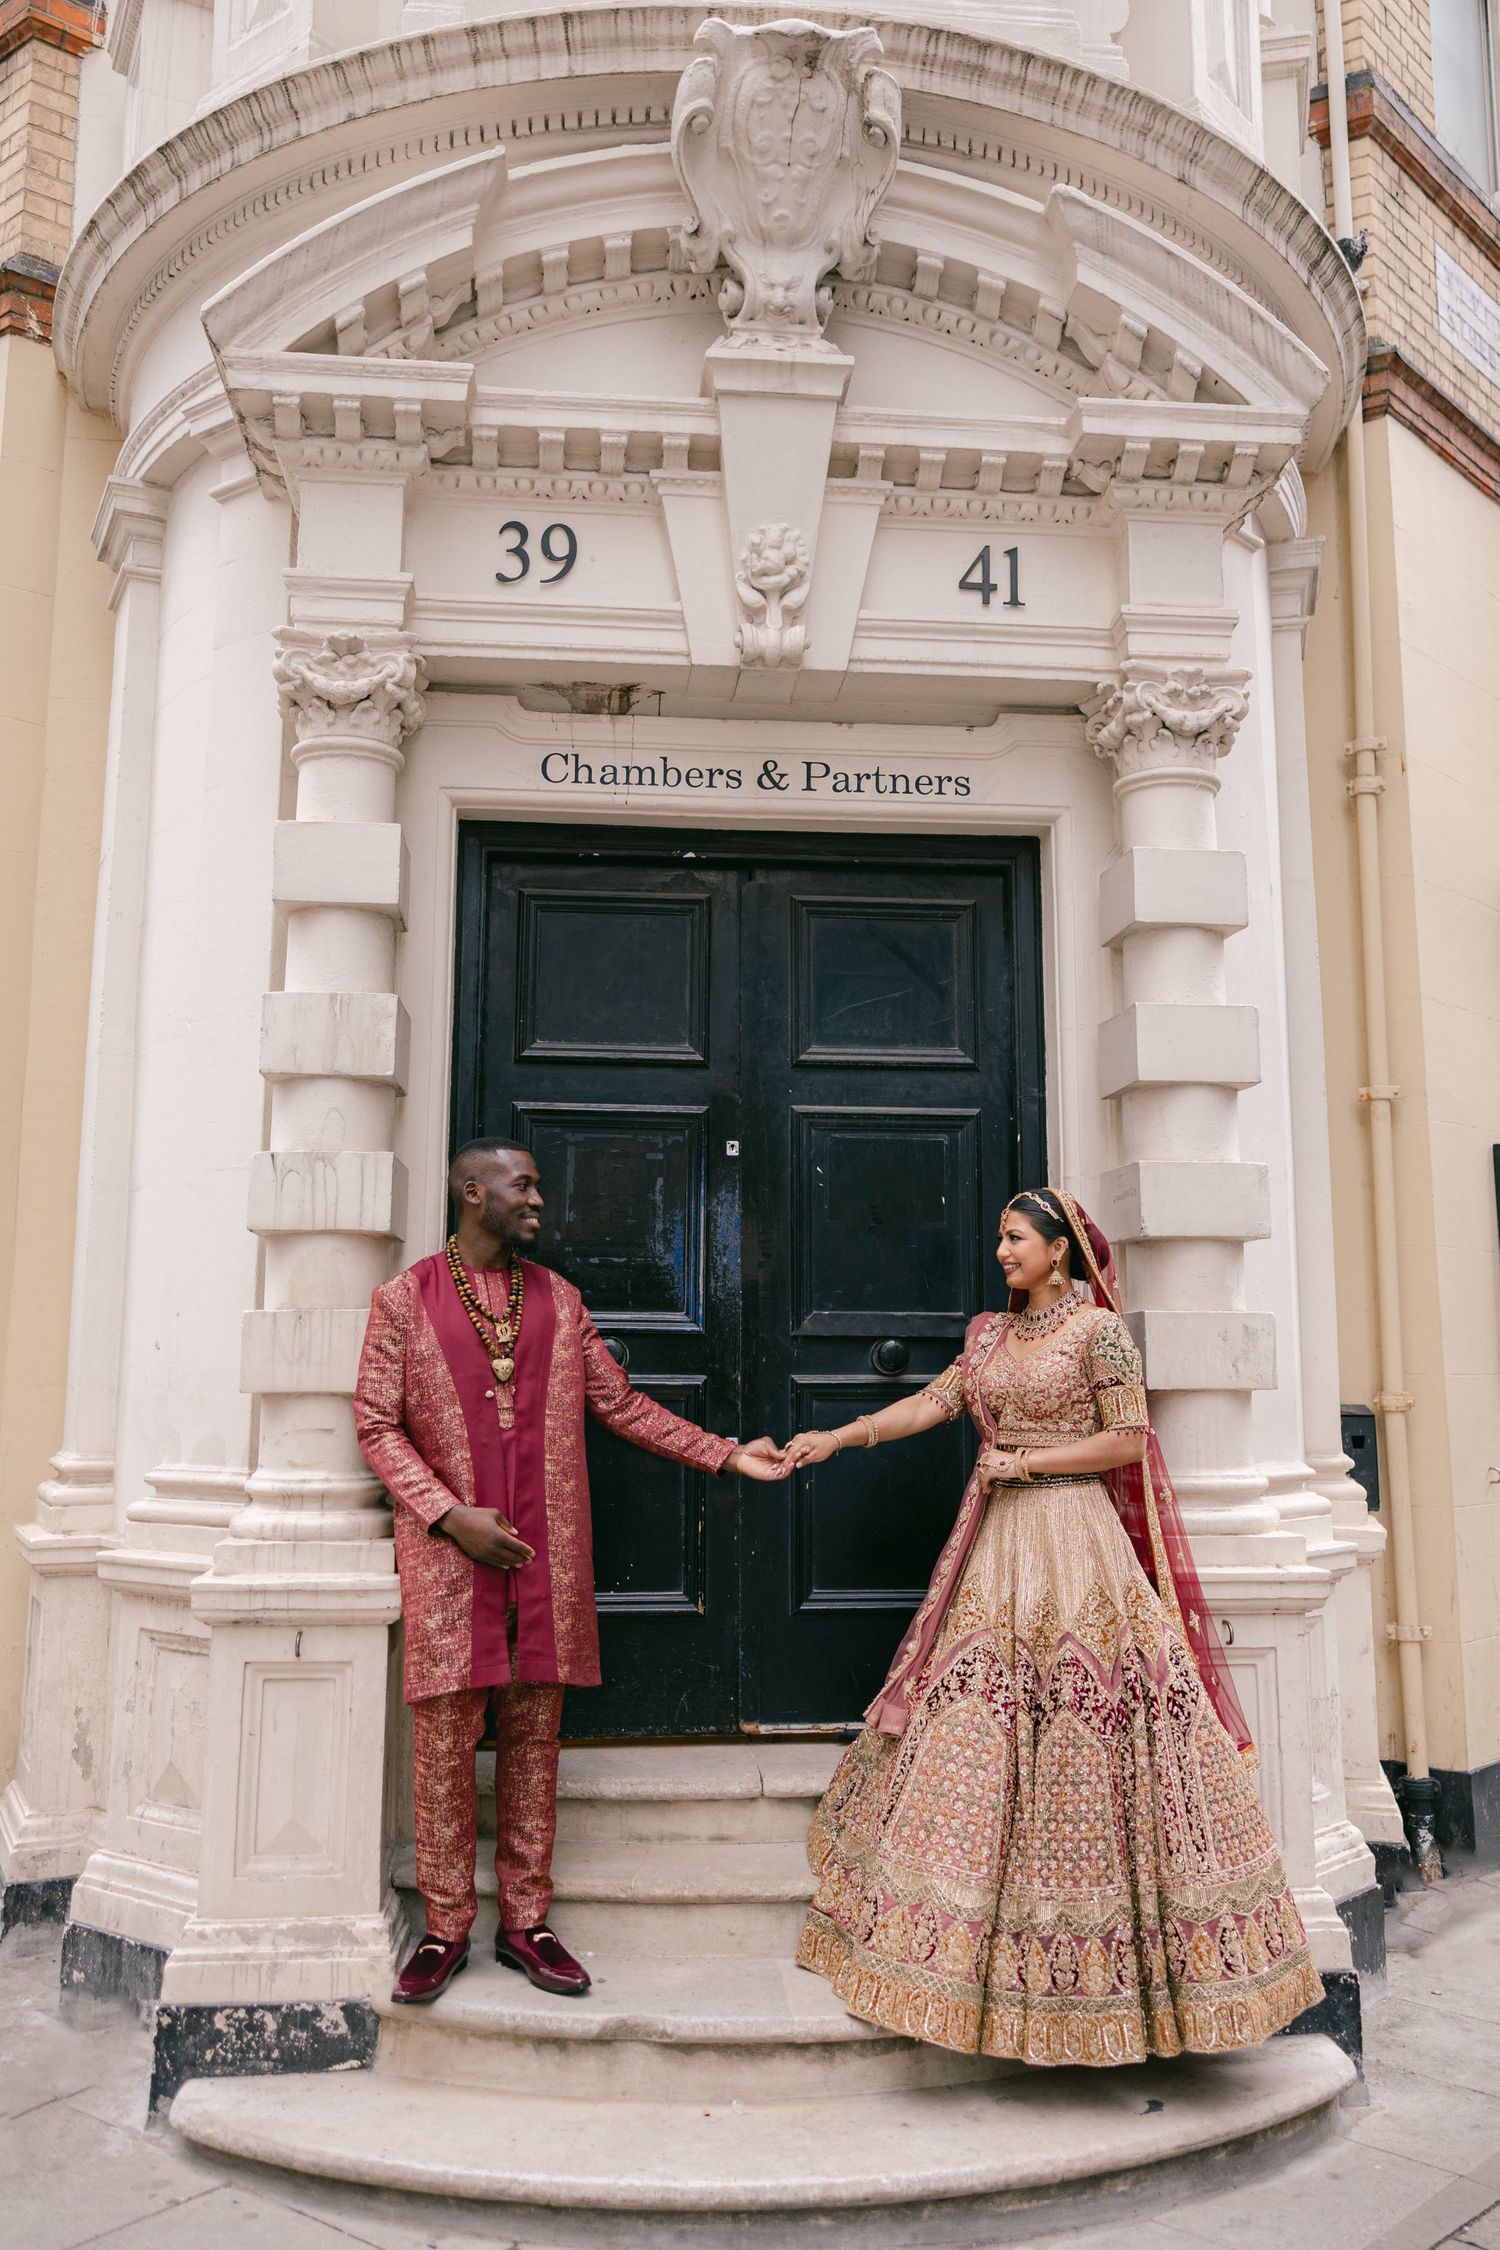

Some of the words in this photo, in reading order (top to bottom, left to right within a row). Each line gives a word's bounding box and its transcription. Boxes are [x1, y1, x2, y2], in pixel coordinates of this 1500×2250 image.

[495, 520, 578, 584] 39
[958, 545, 1026, 608] 41
[540, 752, 743, 790] Chambers
[756, 759, 790, 792] &
[801, 761, 971, 797] Partners
